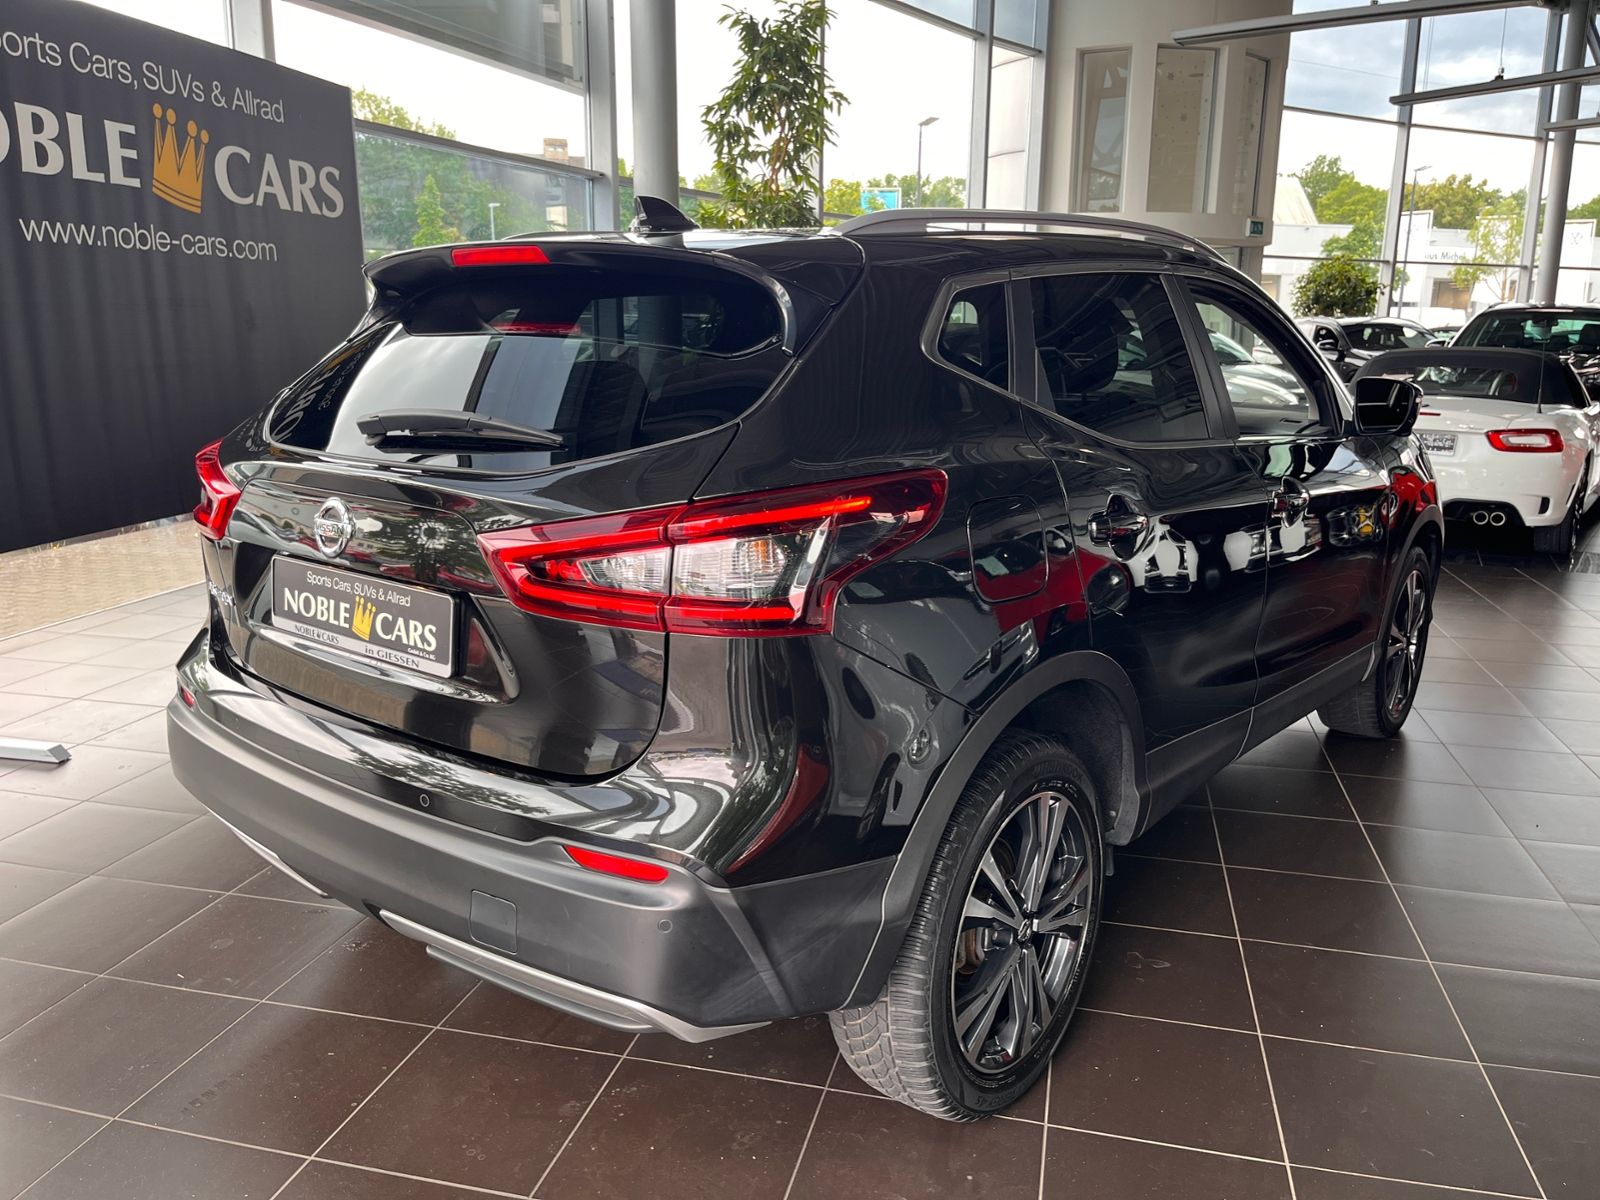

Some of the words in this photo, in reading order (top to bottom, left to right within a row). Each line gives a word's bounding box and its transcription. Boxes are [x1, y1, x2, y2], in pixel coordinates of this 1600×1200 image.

[0, 31, 62, 67] orts
[69, 42, 139, 90] Cars,
[143, 61, 206, 103] SUVs
[211, 81, 228, 109] &
[232, 87, 285, 124] Allrad
[214, 145, 345, 219] CARS
[19, 218, 278, 262] www.noble-cars.com
[306, 570, 332, 588] Sports
[353, 582, 377, 599] SUVs
[377, 588, 385, 601] &
[386, 590, 411, 608] Allrad
[284, 587, 351, 629] NOBLE
[375, 612, 437, 652] CARS
[294, 623, 316, 638] NOBLE
[321, 632, 340, 645] CARS
[364, 645, 374, 656] in
[376, 649, 420, 668] GIESSEN
